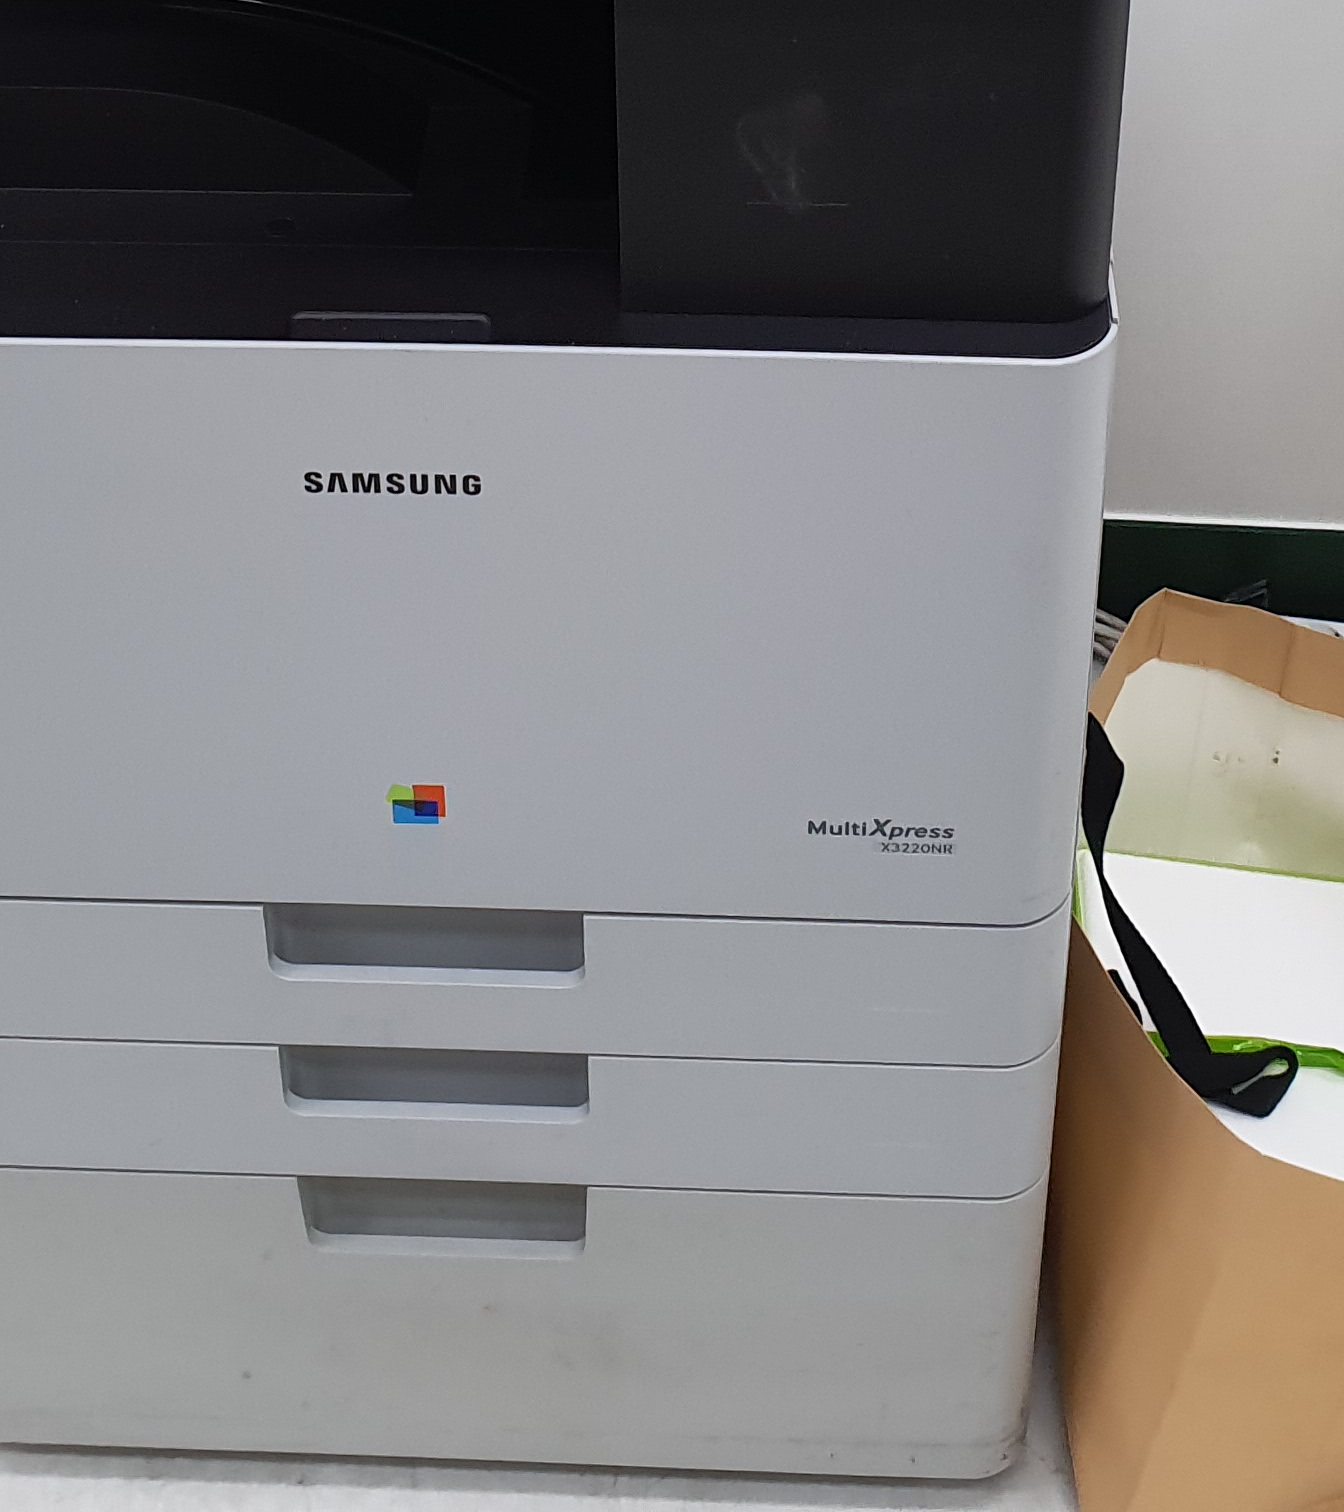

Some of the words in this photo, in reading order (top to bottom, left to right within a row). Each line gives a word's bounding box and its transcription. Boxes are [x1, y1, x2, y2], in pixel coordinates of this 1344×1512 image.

[303, 471, 482, 496] SAMSUNG
[807, 818, 955, 840] MultiXpress
[881, 841, 953, 855] X3220NR
